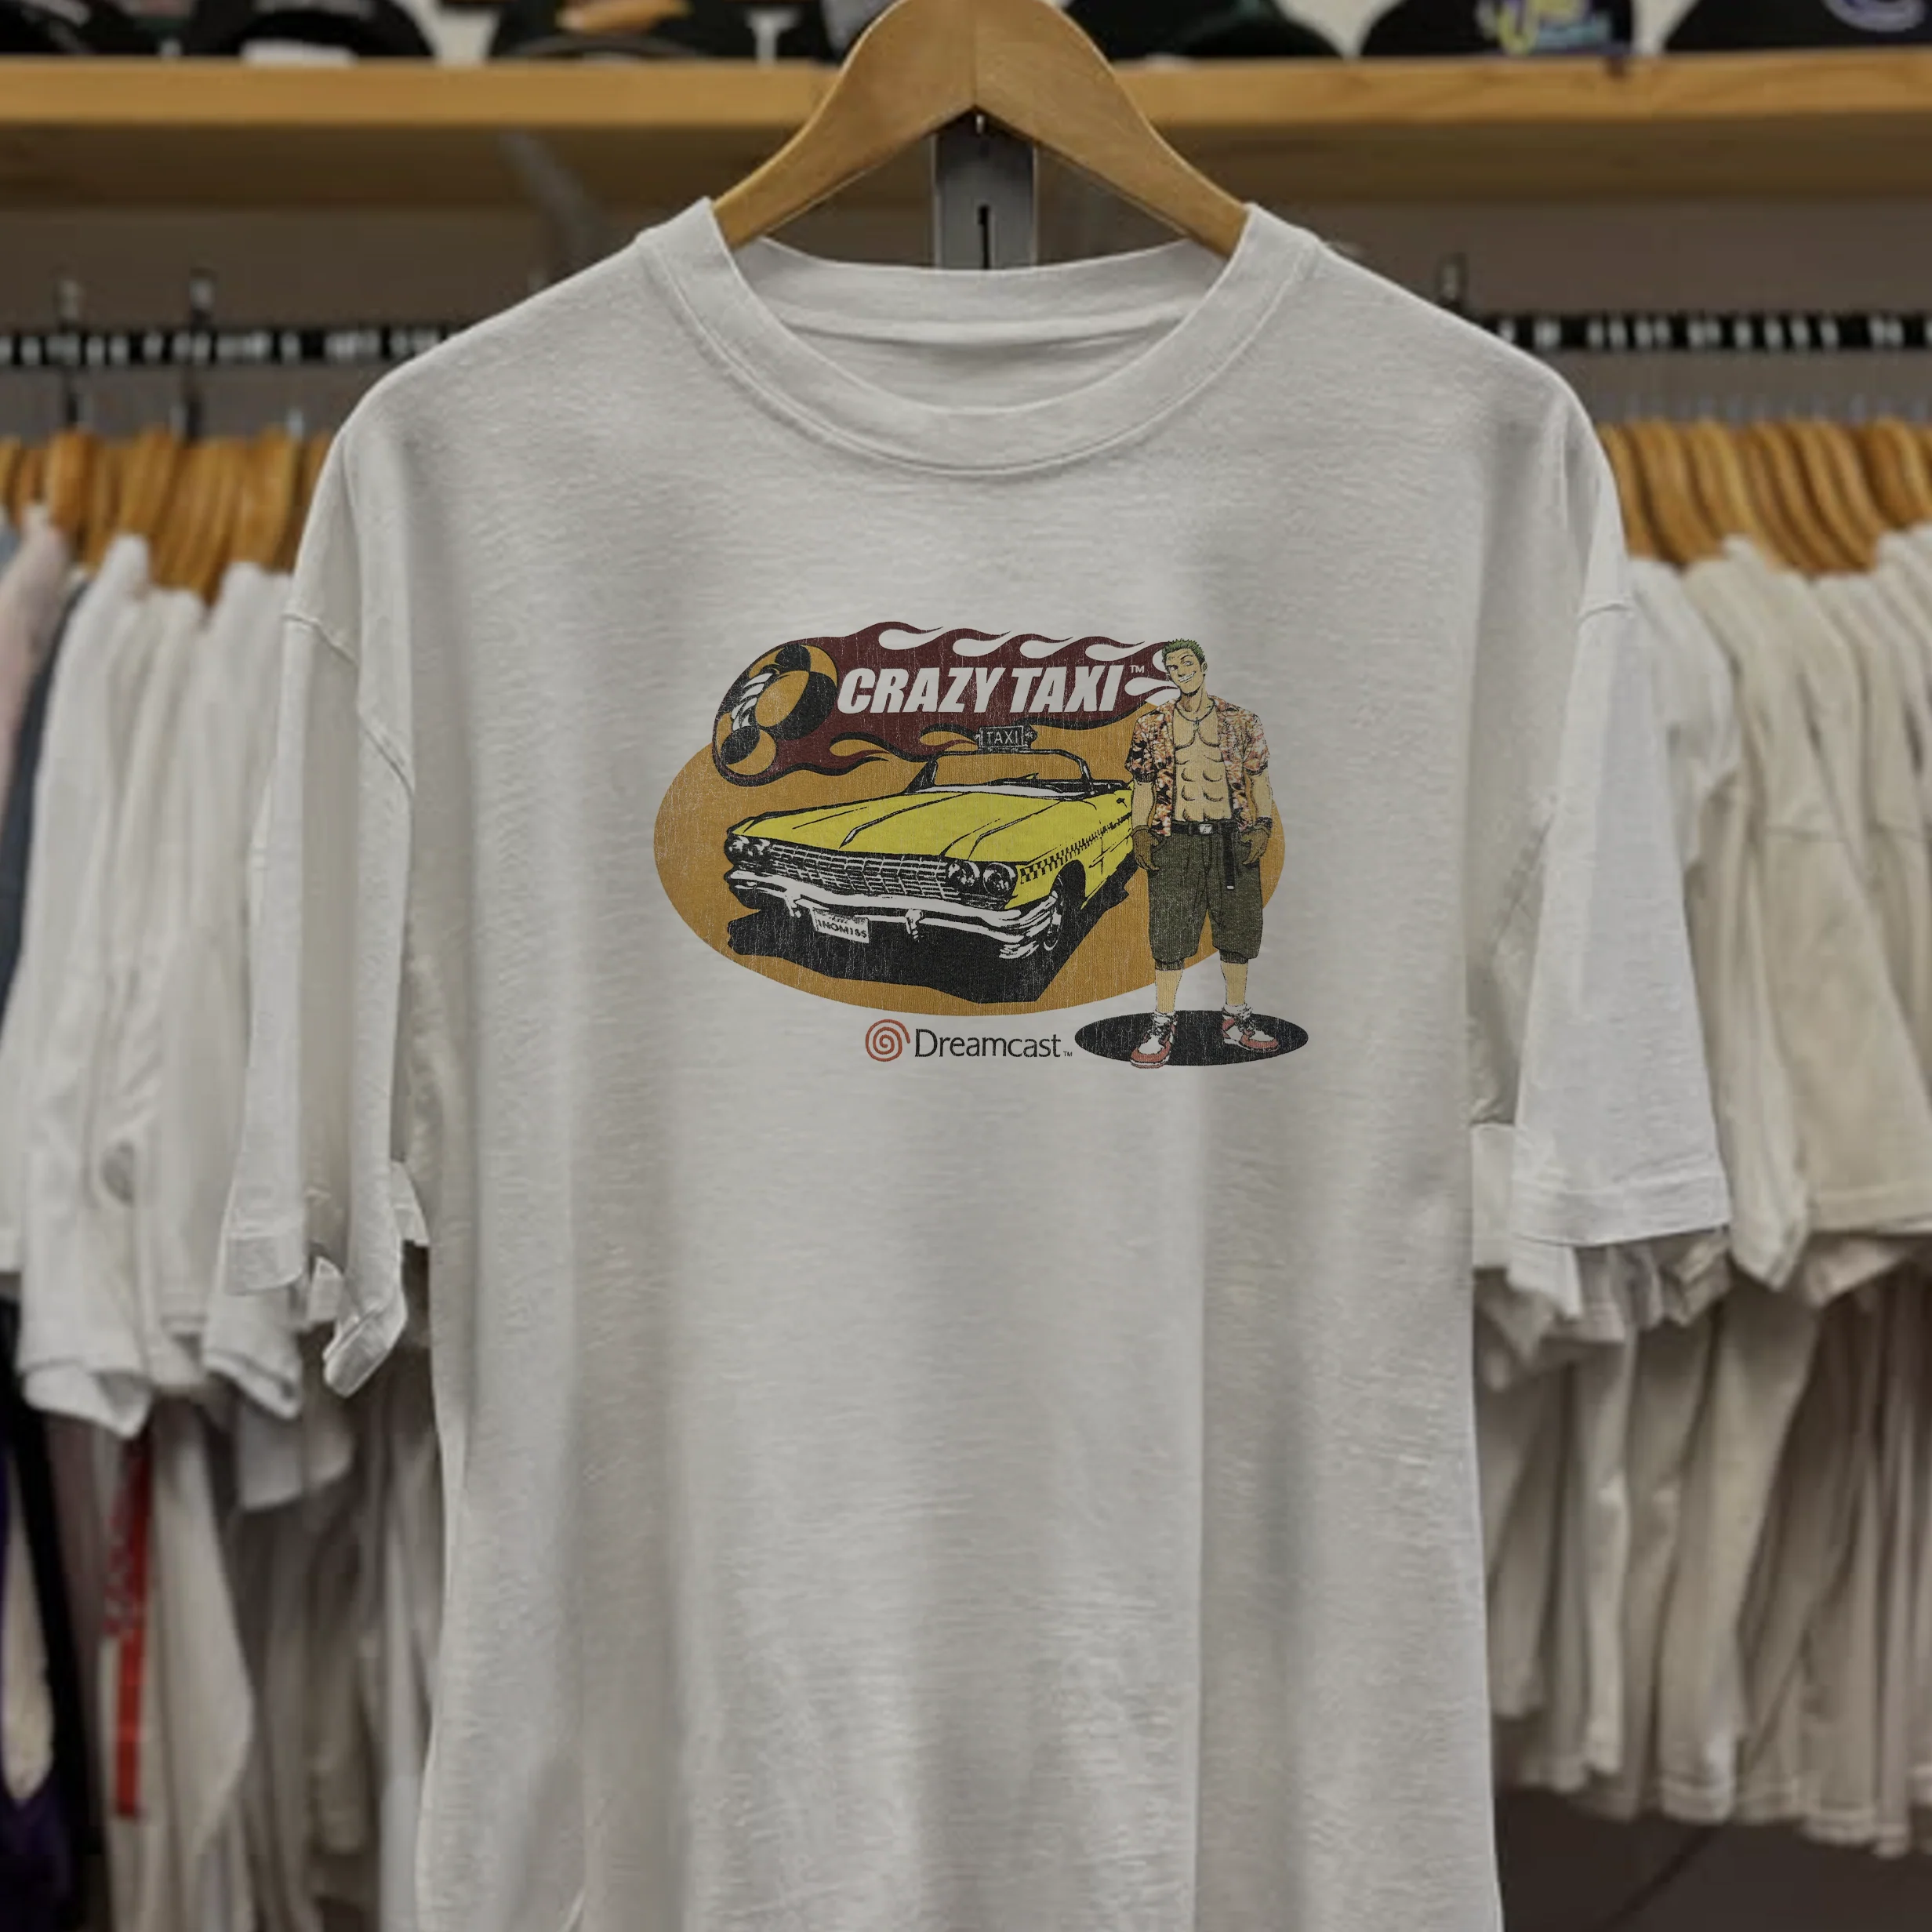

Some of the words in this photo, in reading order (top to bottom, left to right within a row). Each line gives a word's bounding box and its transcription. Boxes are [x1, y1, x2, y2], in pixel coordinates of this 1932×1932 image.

[837, 667, 1004, 714] CRAZY
[1009, 665, 1124, 713] TAXI
[986, 730, 1018, 744] TAXI
[914, 1028, 1062, 1058] Dreamcast
